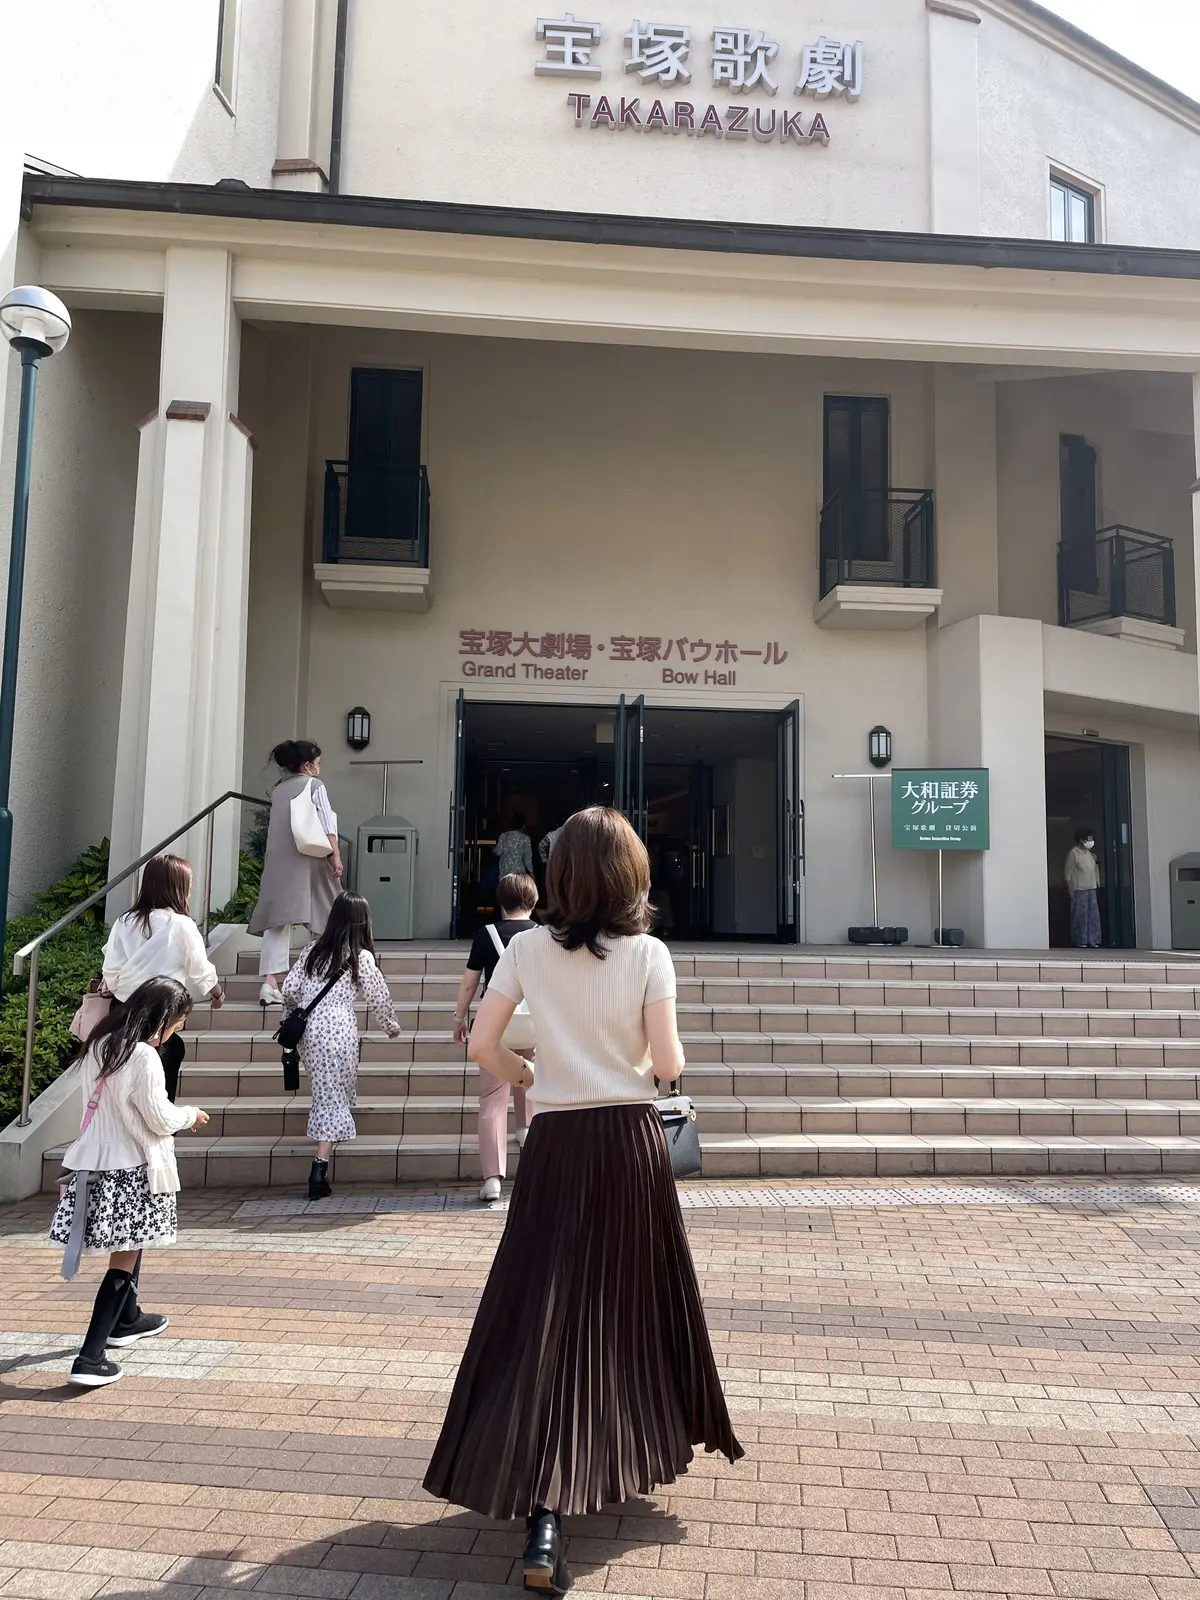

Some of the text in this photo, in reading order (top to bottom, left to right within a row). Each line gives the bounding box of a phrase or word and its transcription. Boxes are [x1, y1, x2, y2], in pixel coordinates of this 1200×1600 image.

[534, 12, 865, 102] 宝塚歌劇
[567, 92, 831, 146] TAKARAZUKA
[458, 628, 788, 665] 宝塚大劇場・宝塚バウホール
[462, 660, 589, 681] Grand Theater
[662, 668, 736, 686] Bow Hall
[901, 780, 979, 799] 大和証券
[911, 799, 970, 815] グループ
